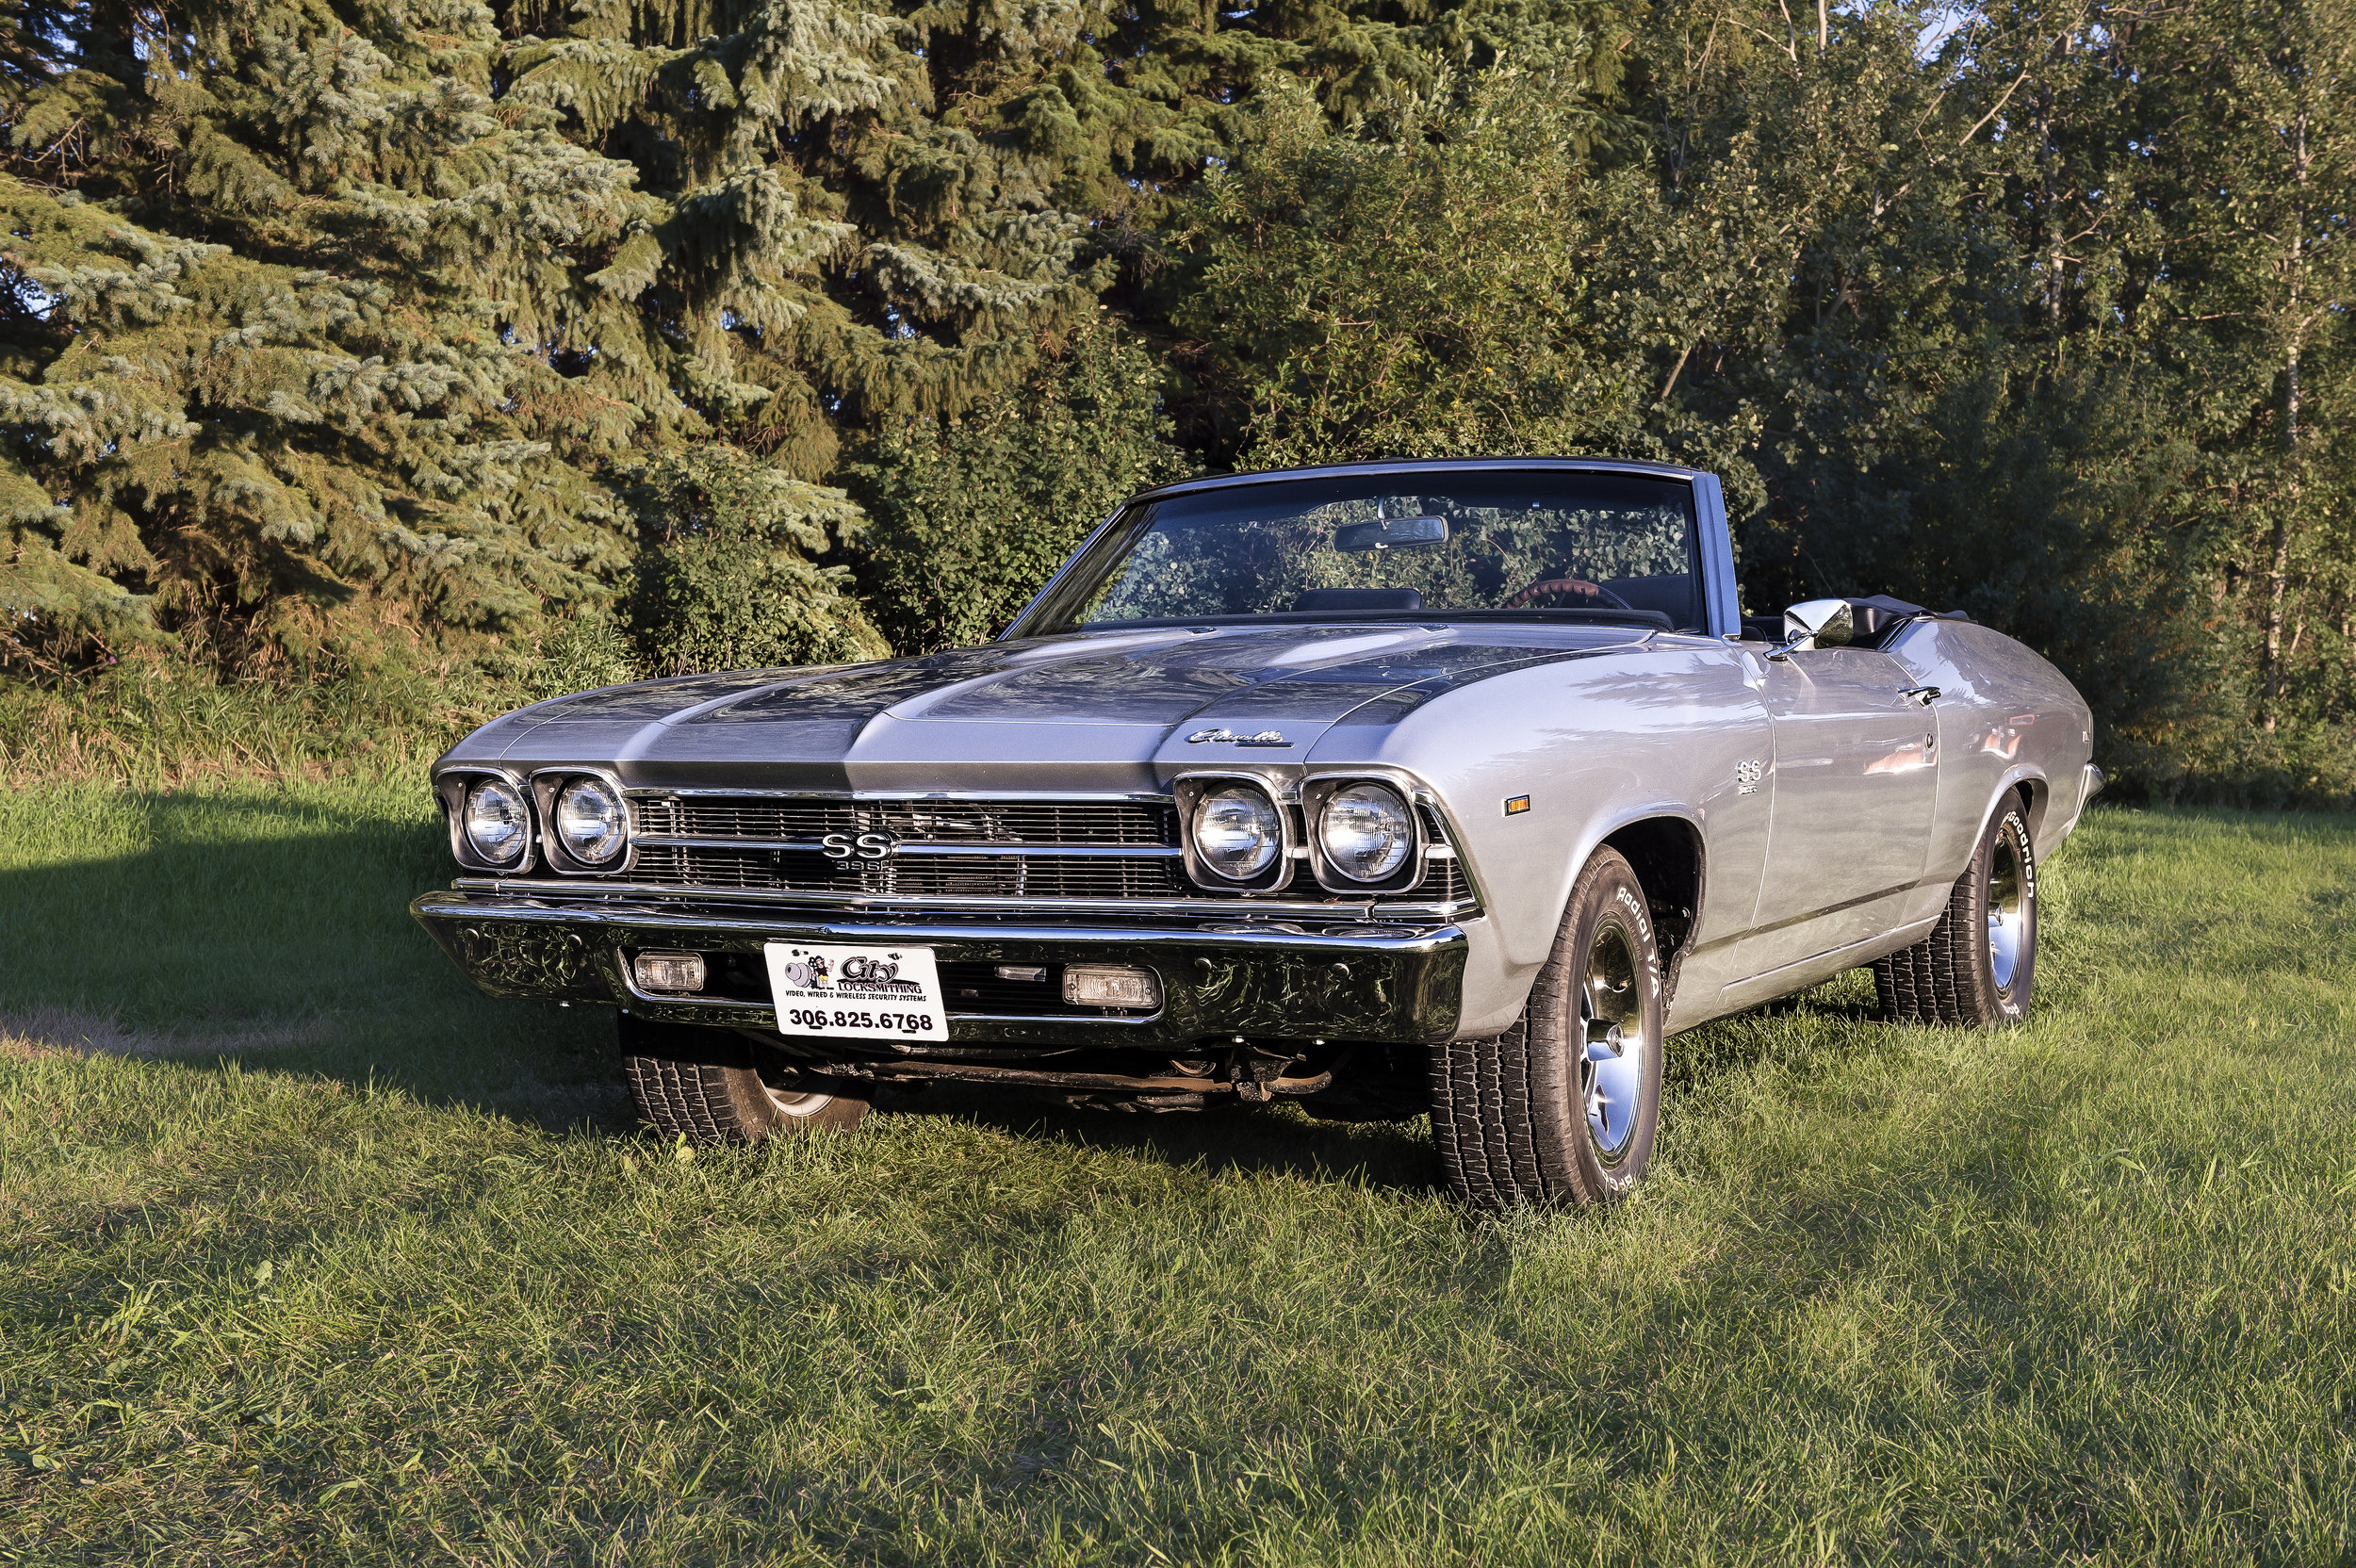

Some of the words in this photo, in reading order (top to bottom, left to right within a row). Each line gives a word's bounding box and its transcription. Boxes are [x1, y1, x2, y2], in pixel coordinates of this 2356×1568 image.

[1737, 760, 1761, 782] SS
[822, 834, 889, 858] SS
[836, 861, 880, 871] 396
[1616, 887, 1651, 943] Radial
[841, 956, 899, 984] City
[785, 989, 806, 998] VIDEO,
[807, 990, 828, 999] WIRED
[868, 993, 898, 1002] SECURITY
[838, 982, 923, 994] LOCKSMITHING
[789, 1009, 933, 1031] 306.825.6768
